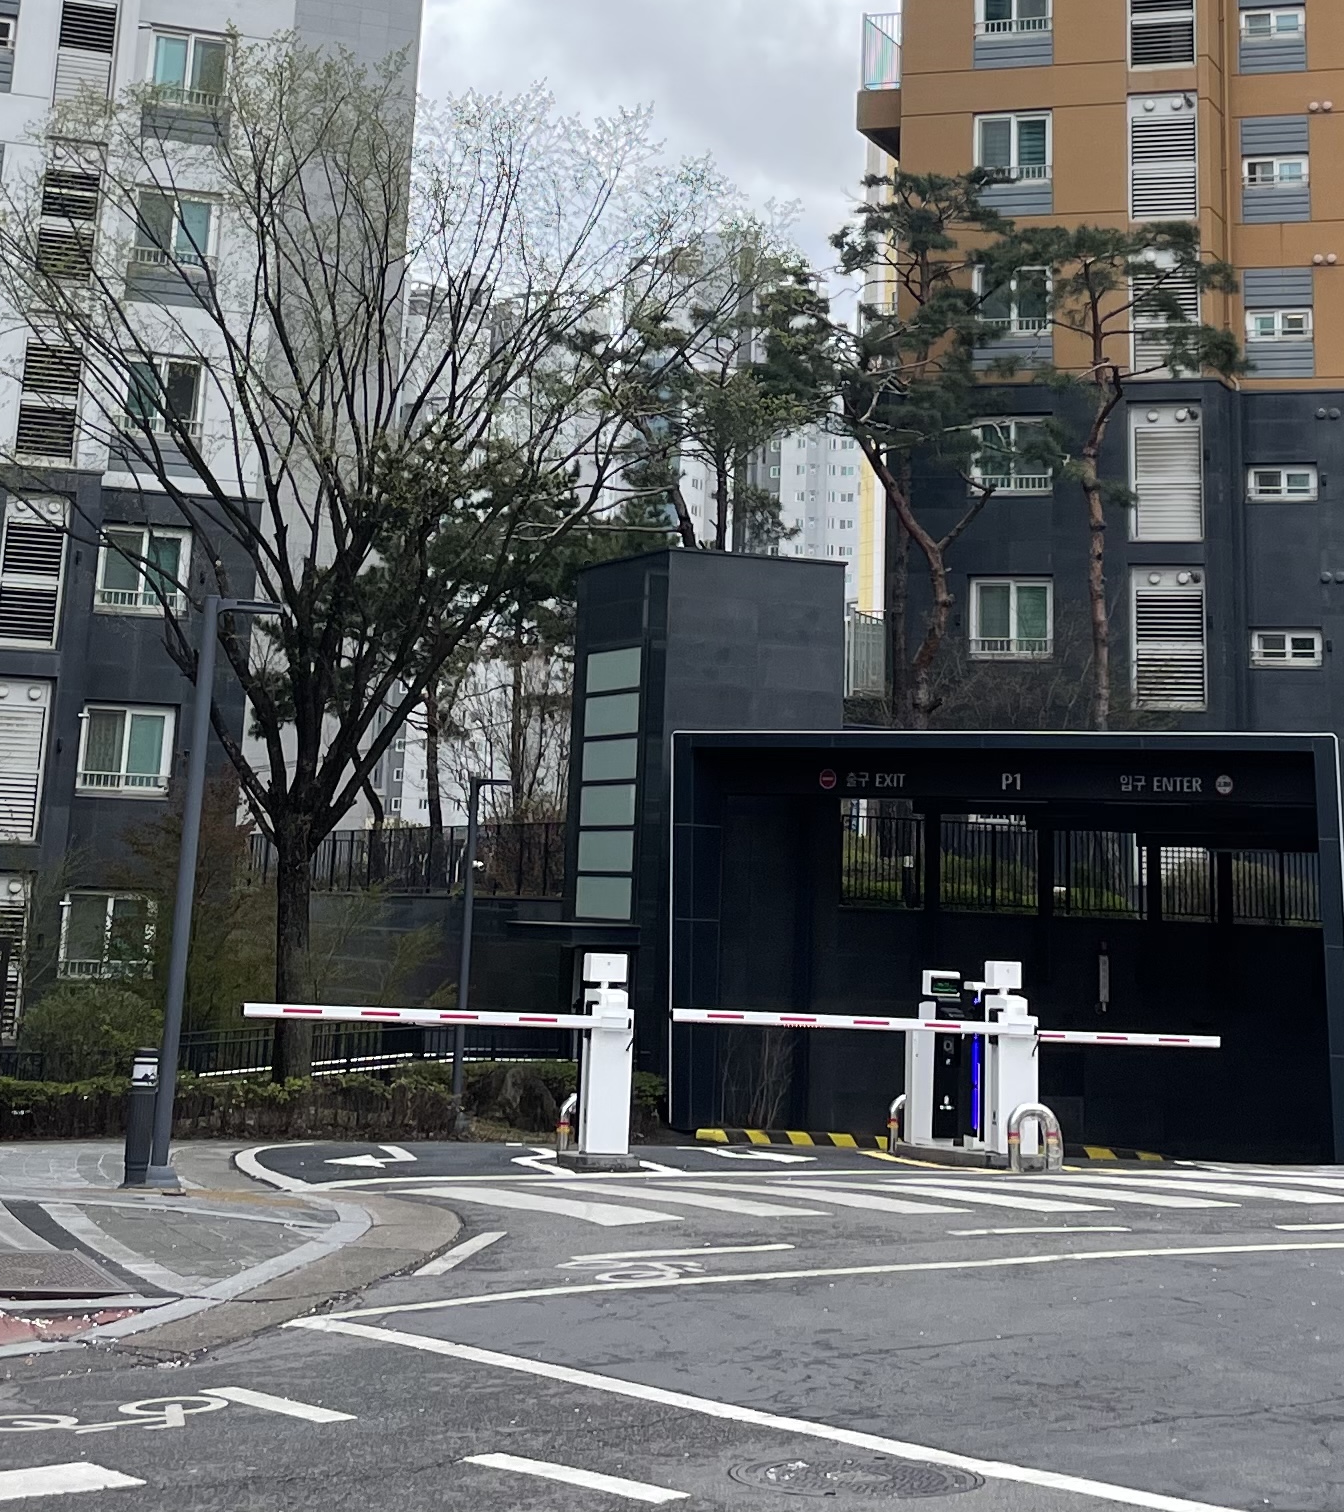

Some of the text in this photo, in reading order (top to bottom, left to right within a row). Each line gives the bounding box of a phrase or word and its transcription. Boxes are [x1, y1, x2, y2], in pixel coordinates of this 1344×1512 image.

[846, 772, 905, 788] 출구 EXIT
[1002, 773, 1021, 791] P1
[1120, 775, 1146, 792] 입구
[1153, 777, 1202, 792] ENTER
